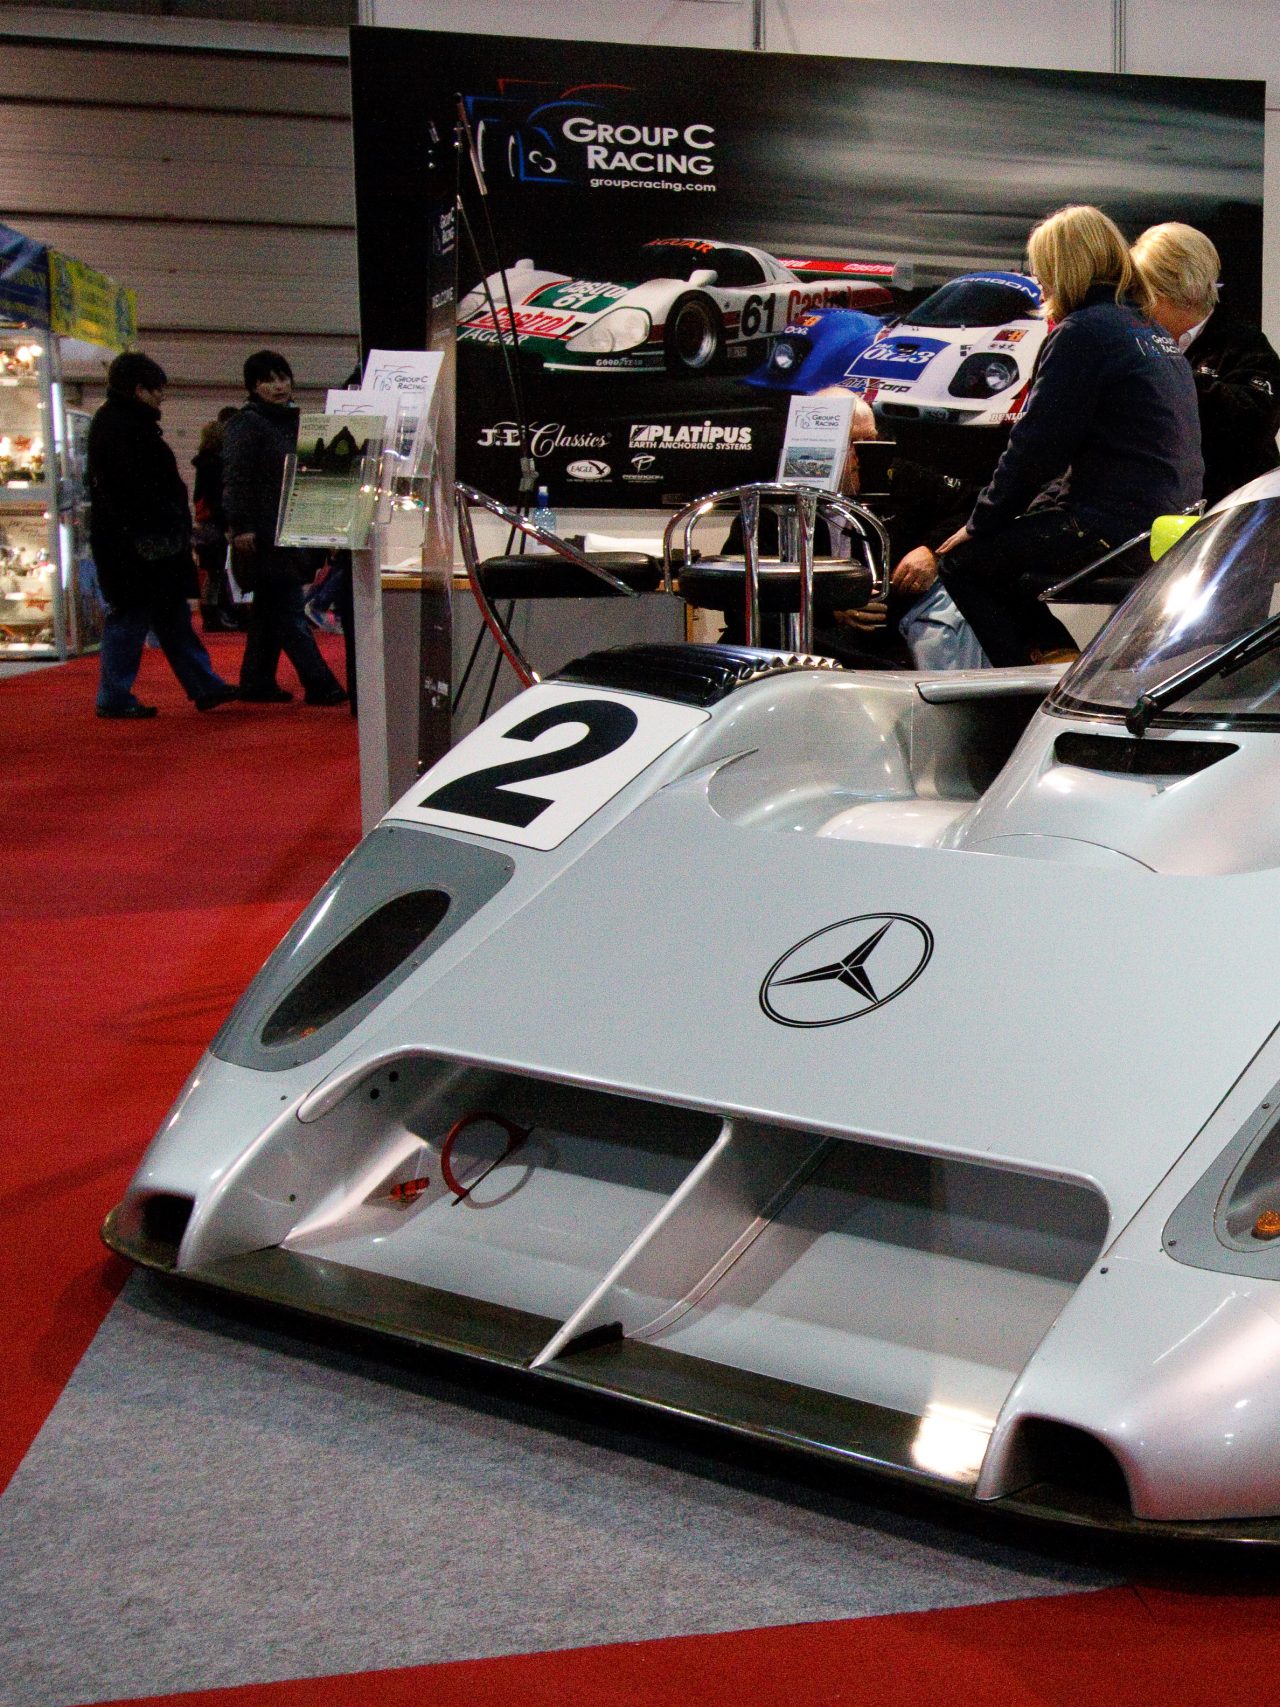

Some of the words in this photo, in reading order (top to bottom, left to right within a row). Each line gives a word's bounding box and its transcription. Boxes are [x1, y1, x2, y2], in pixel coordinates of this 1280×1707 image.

[562, 117, 679, 147] GROUP
[683, 124, 715, 149] C
[587, 145, 715, 176] RACING
[590, 178, 717, 192] groupcracing.com
[553, 295, 598, 309] 61
[741, 292, 776, 337] 61
[478, 307, 576, 332] Castrol
[529, 422, 609, 458] Classics
[629, 441, 657, 449] EARTH
[658, 441, 714, 450] ANCHORING
[715, 443, 753, 451] SYSTEMS
[570, 465, 594, 474] EAGLE
[417, 699, 638, 829] 2
